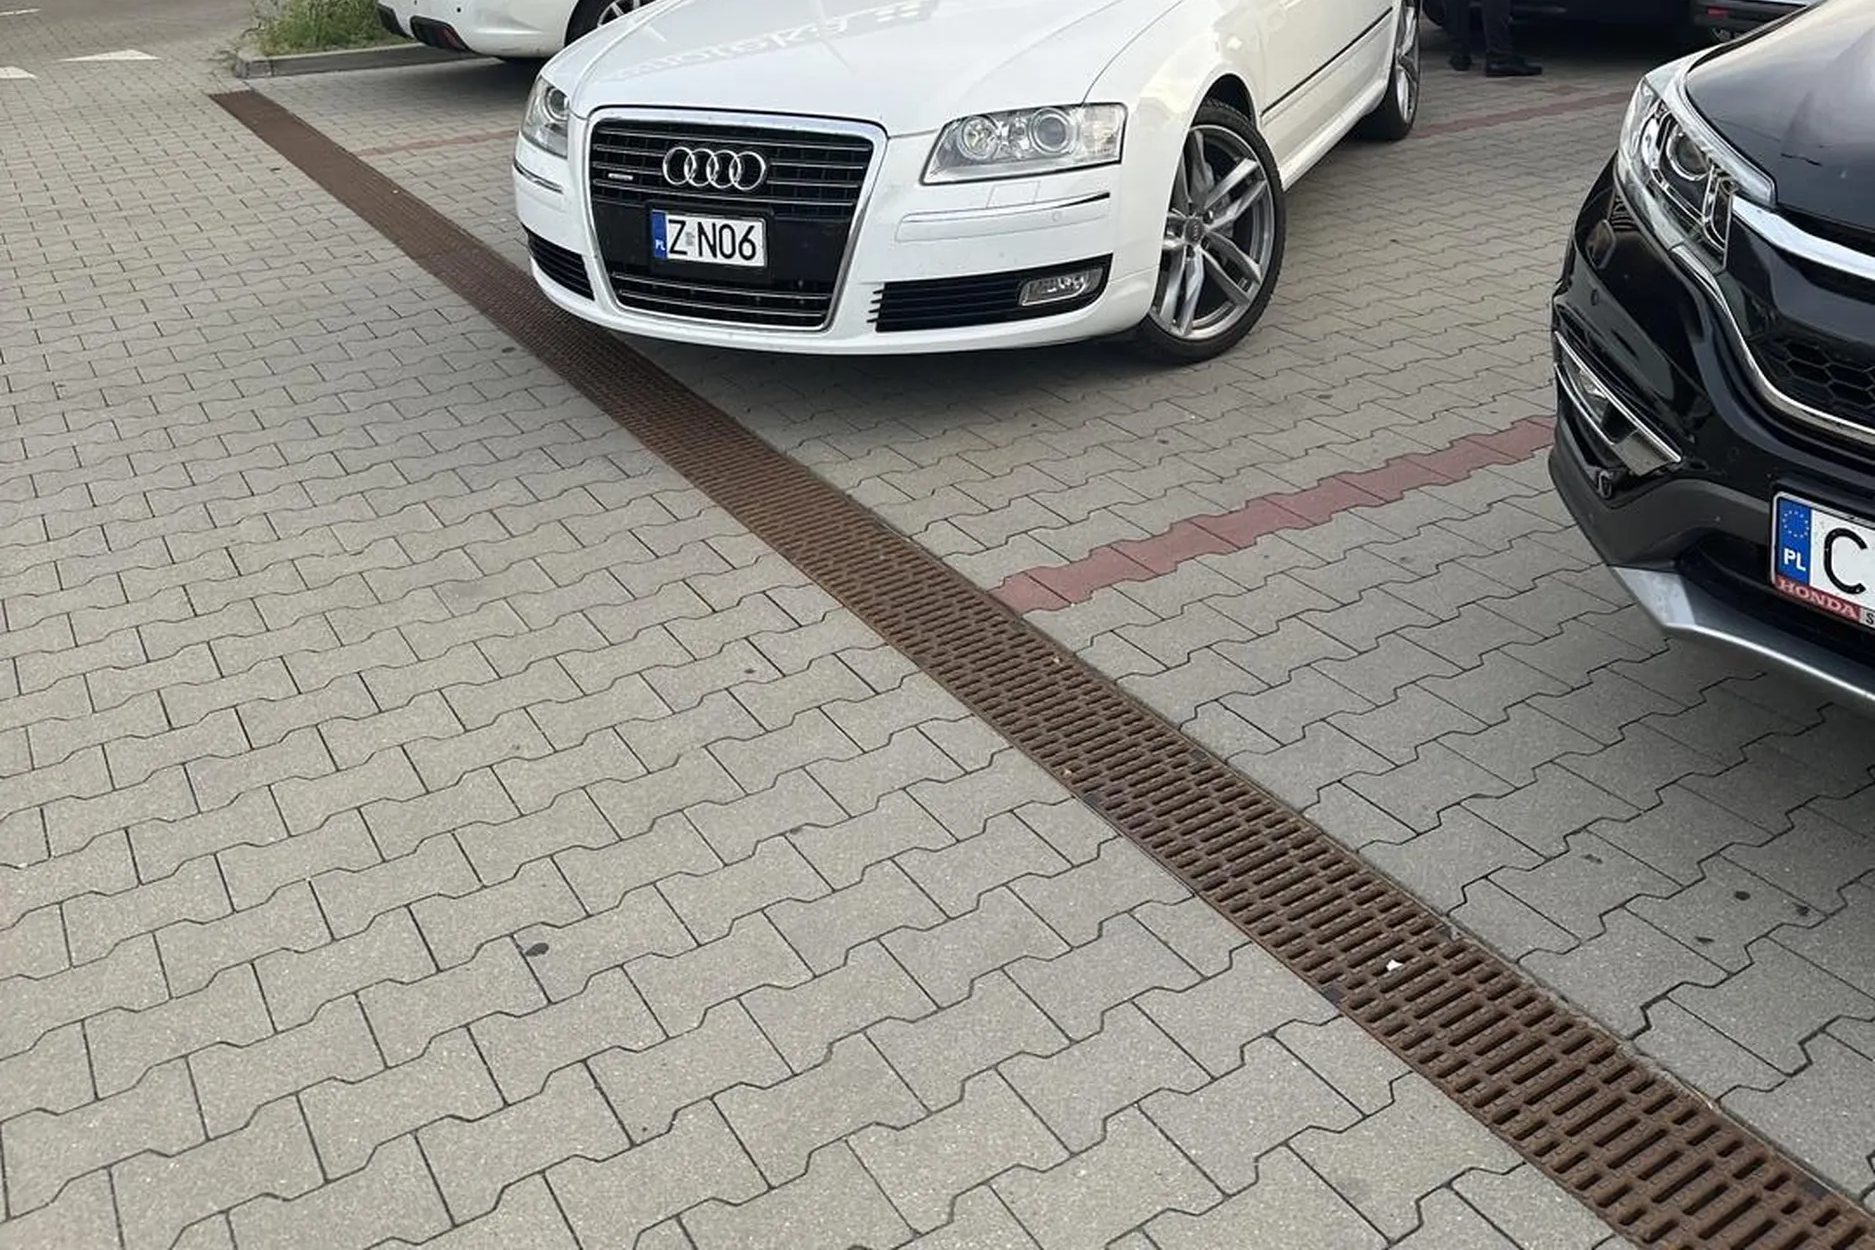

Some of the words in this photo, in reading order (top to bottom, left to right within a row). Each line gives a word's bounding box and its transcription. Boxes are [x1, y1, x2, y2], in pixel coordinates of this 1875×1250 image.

[1783, 547, 1807, 572] PL
[1823, 527, 1868, 595] C
[1776, 576, 1860, 620] HONDA
